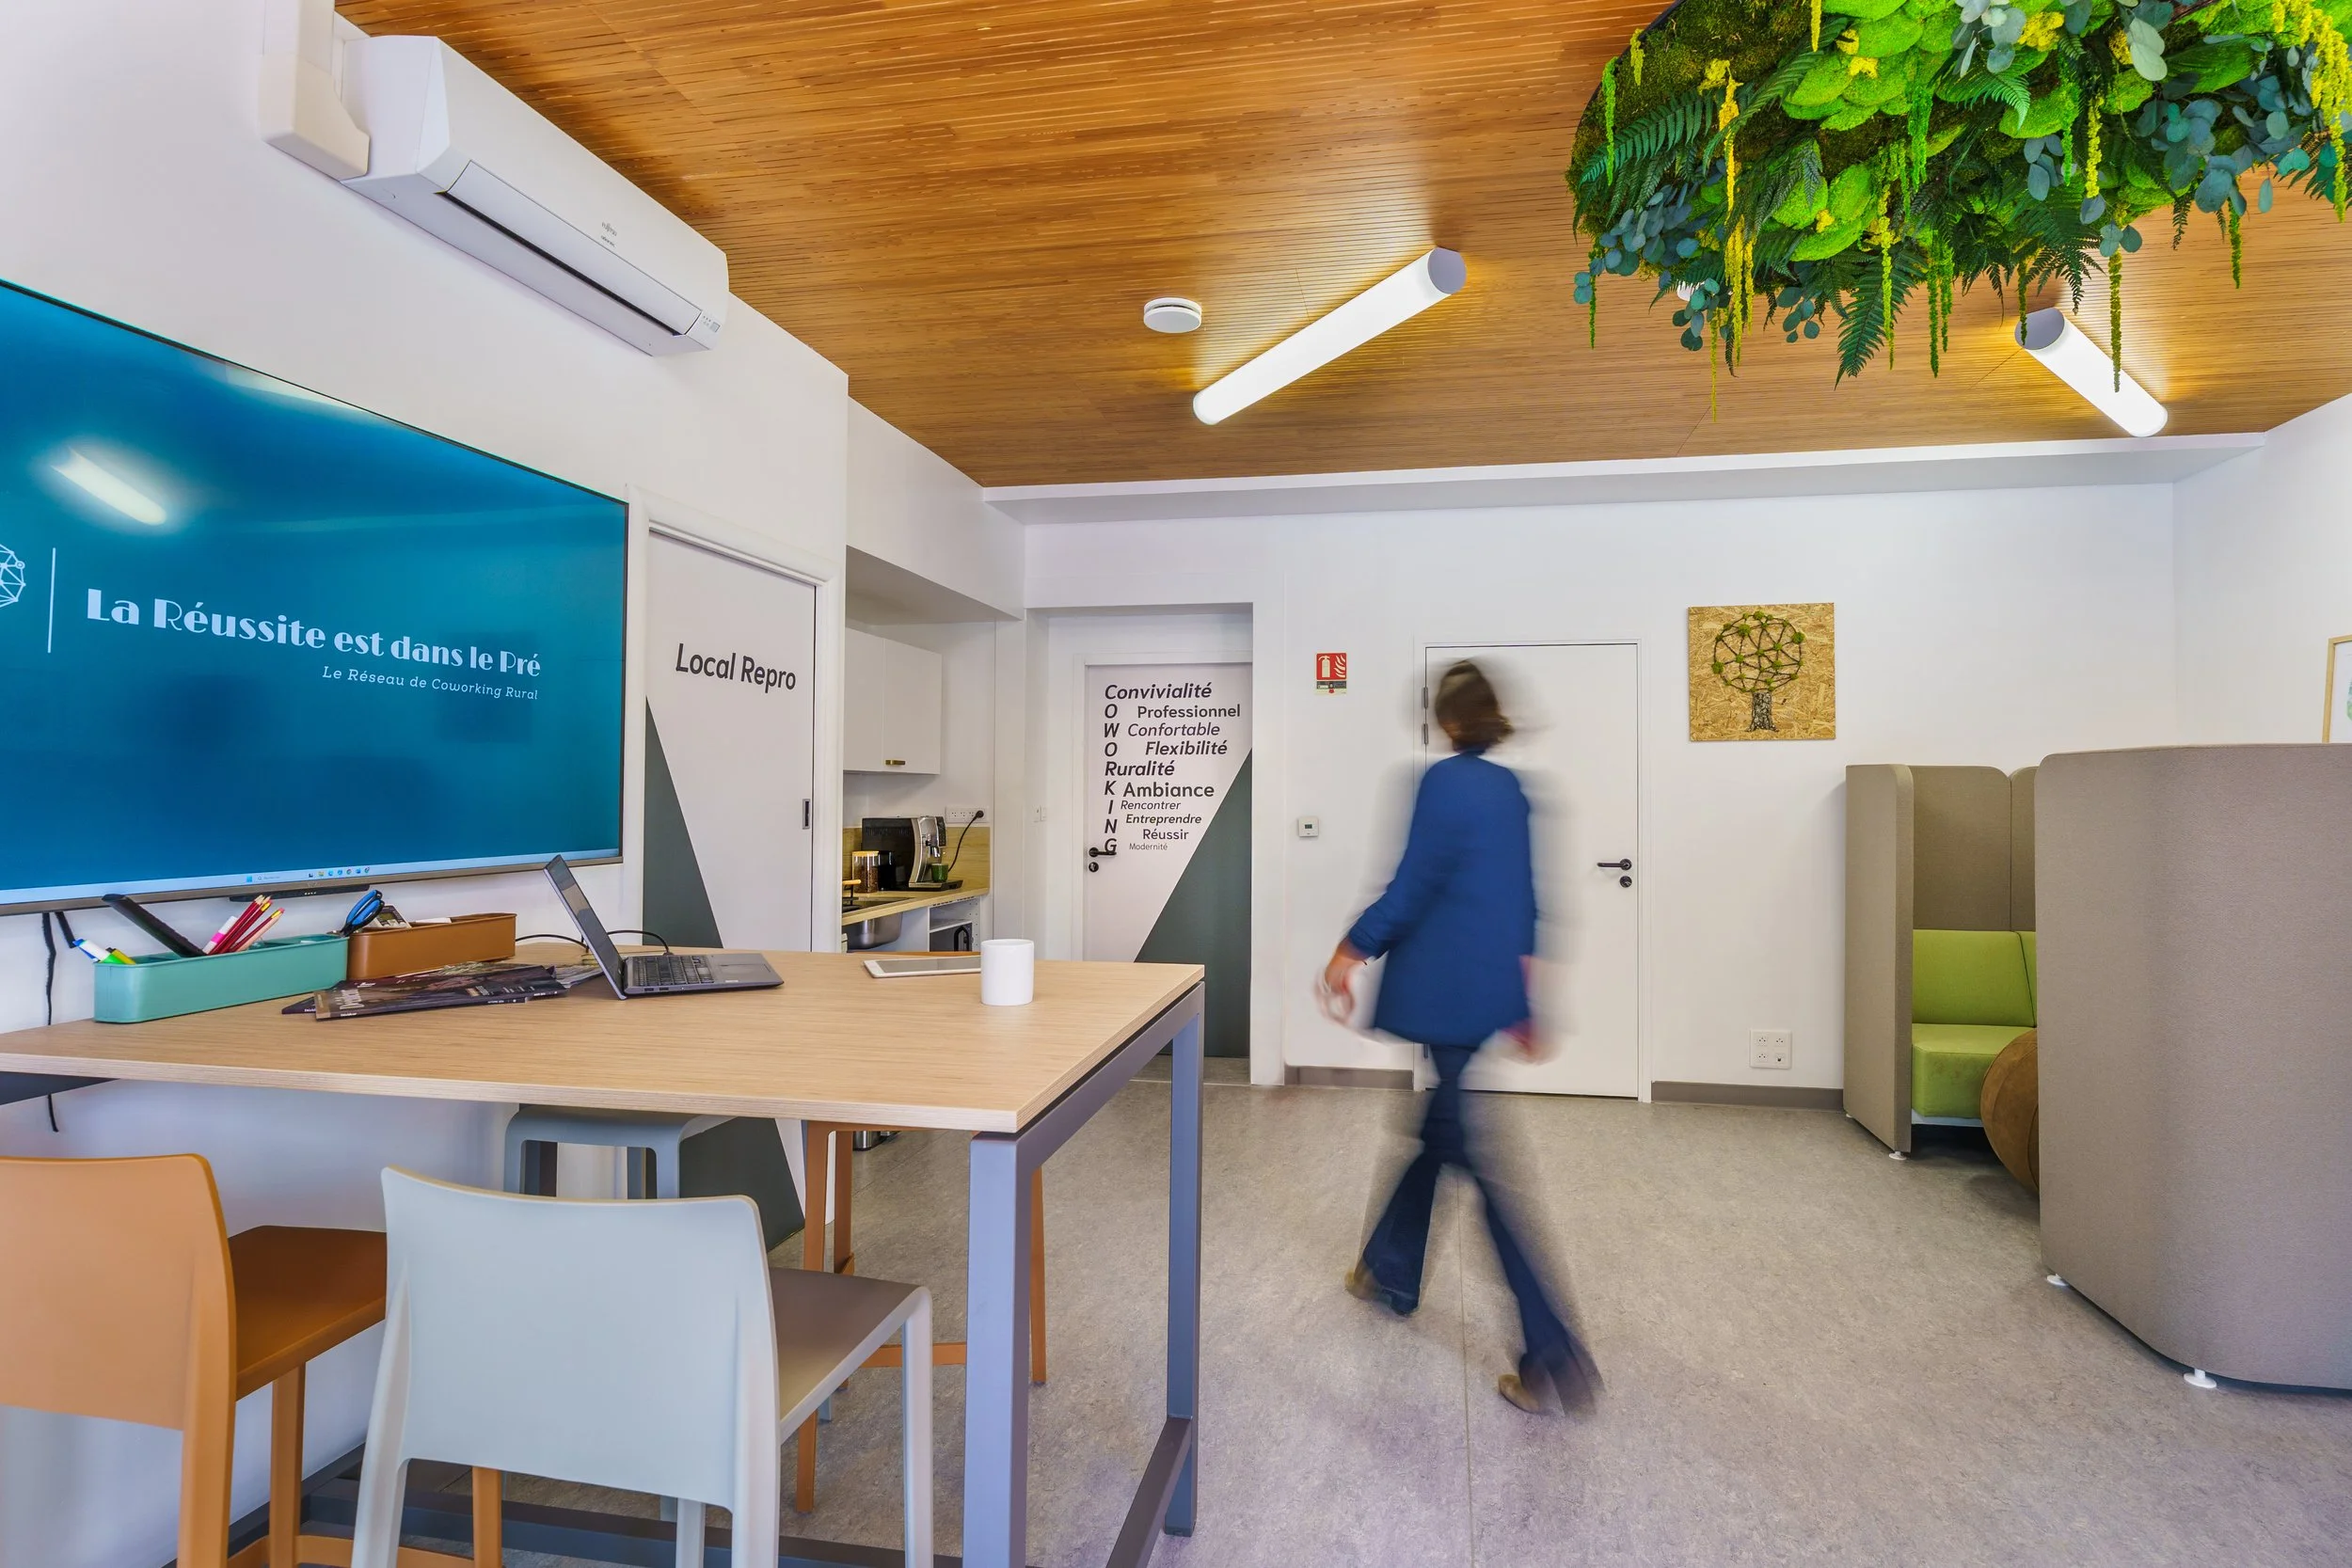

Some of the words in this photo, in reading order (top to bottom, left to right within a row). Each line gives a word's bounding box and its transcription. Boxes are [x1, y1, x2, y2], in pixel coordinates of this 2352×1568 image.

[87, 588, 139, 625] La
[154, 598, 326, 648] Réussite
[334, 632, 384, 656] est
[391, 636, 463, 666] dans
[470, 646, 493, 670] le
[501, 651, 540, 676] Pré
[675, 643, 736, 680] Local
[741, 656, 795, 693] Repro
[323, 666, 342, 678] Le
[348, 669, 404, 685] Réseau
[410, 676, 426, 688] de
[432, 679, 501, 698] Coworking
[506, 687, 537, 699] Rural
[1105, 682, 1212, 699] Convivialité
[1138, 704, 1240, 718] Professionnel
[1128, 722, 1220, 736] Confortable
[1146, 740, 1227, 754] Flexibilité
[1105, 760, 1174, 776] Ruralité
[1123, 782, 1214, 797] Ambiance
[1120, 800, 1181, 810] Rencontrer
[1126, 814, 1201, 826] Entreprendre
[1143, 829, 1188, 839] Réussir
